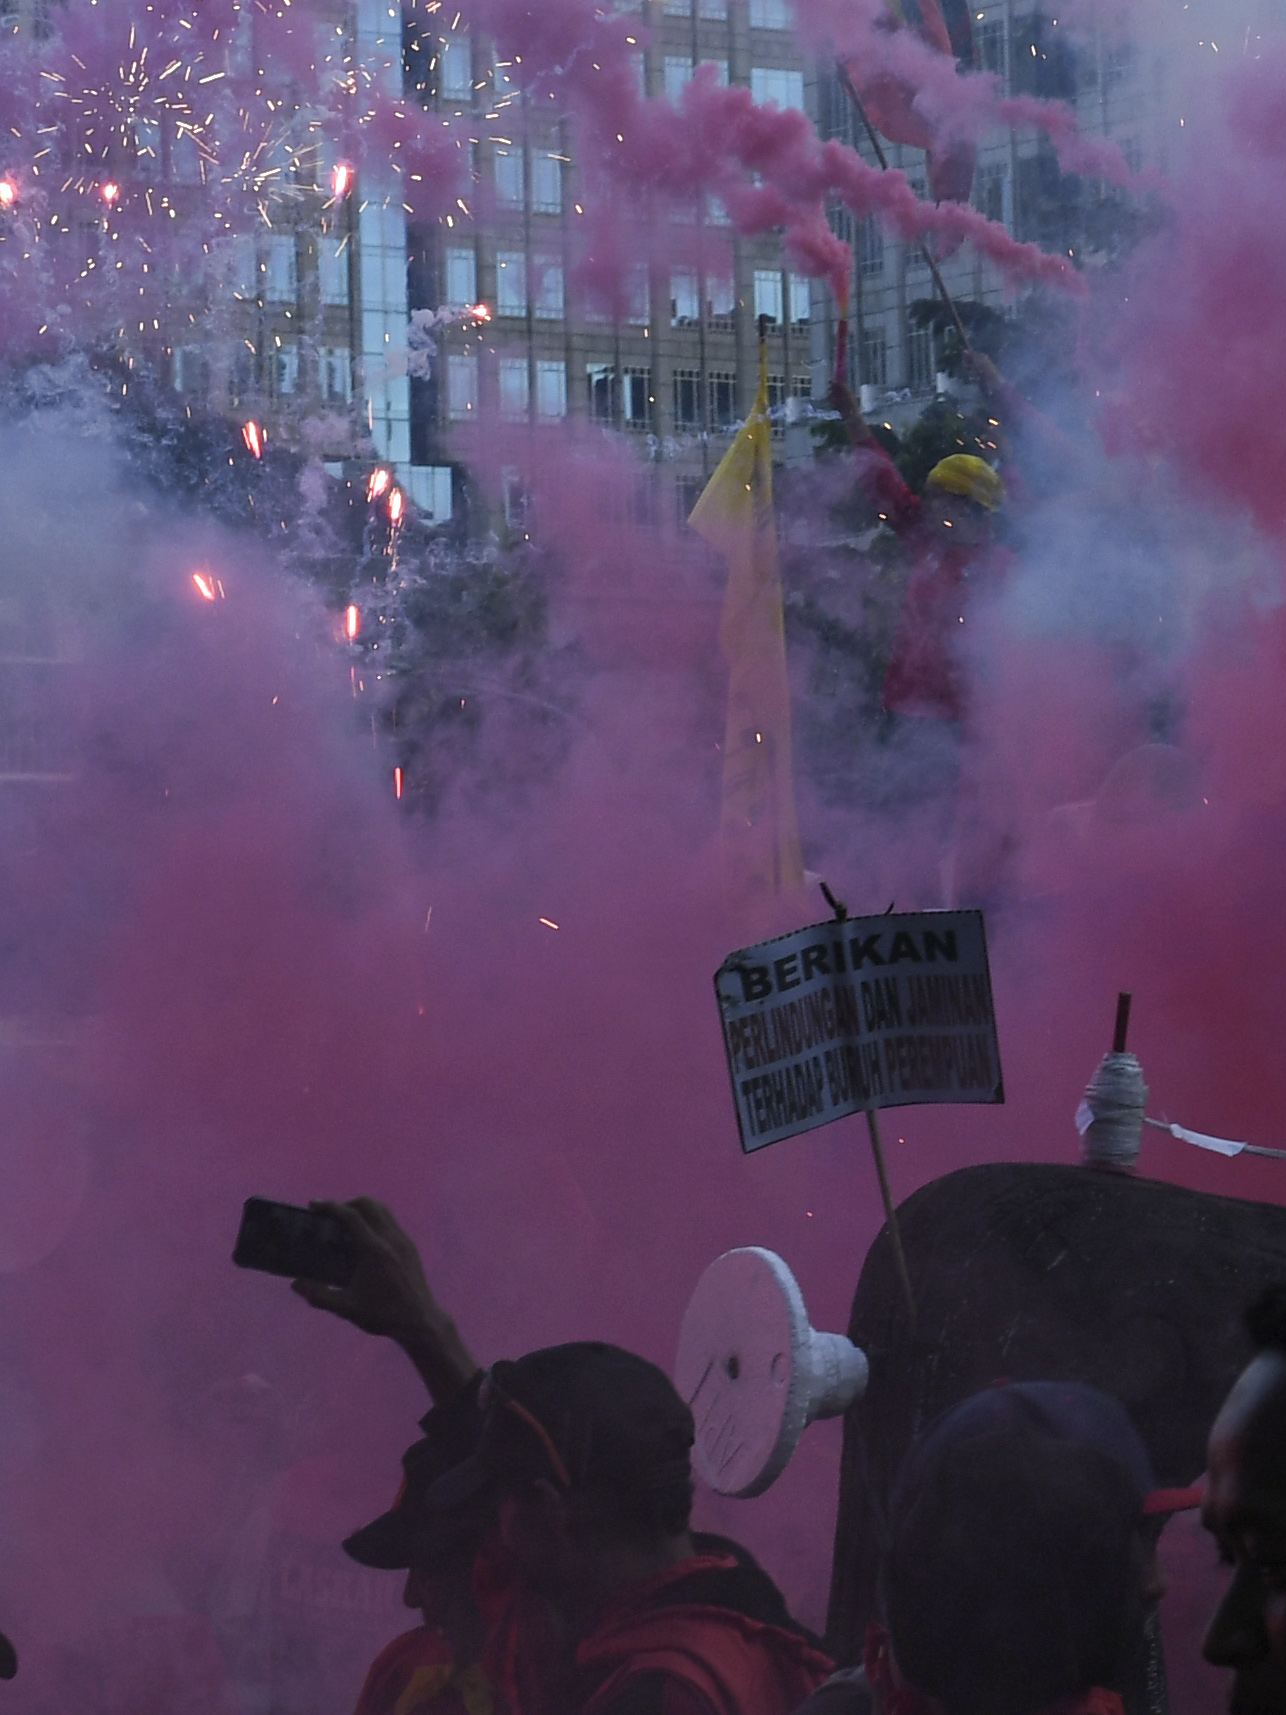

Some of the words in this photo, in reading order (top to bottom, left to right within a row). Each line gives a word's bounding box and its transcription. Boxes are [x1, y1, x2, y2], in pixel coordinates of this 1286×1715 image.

[740, 930, 958, 1002] BERIKAN
[729, 984, 860, 1071] PERLINDUNGAN
[861, 976, 902, 1032] DAN
[741, 1056, 825, 1137] TERHADAP
